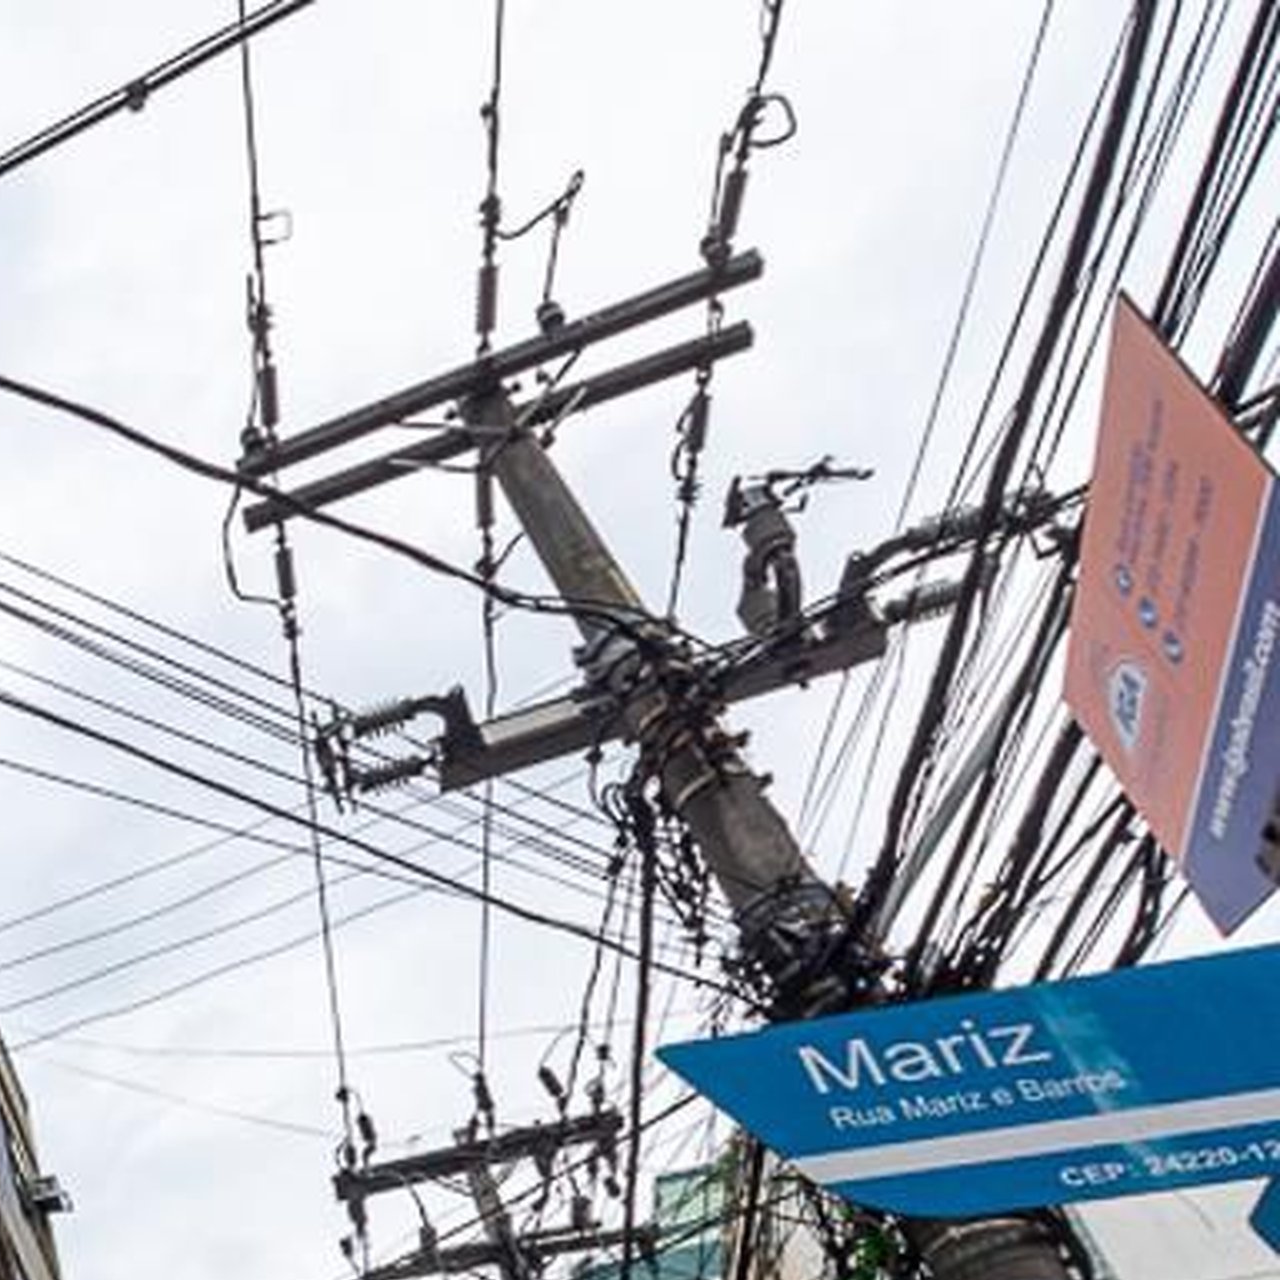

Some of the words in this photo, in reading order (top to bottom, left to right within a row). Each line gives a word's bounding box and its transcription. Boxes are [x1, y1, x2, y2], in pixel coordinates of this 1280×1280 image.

[798, 1018, 1053, 1094] Mariz
[829, 1104, 896, 1130] Rua
[899, 1091, 988, 1122] Mariz
[990, 1088, 1015, 1106] e
